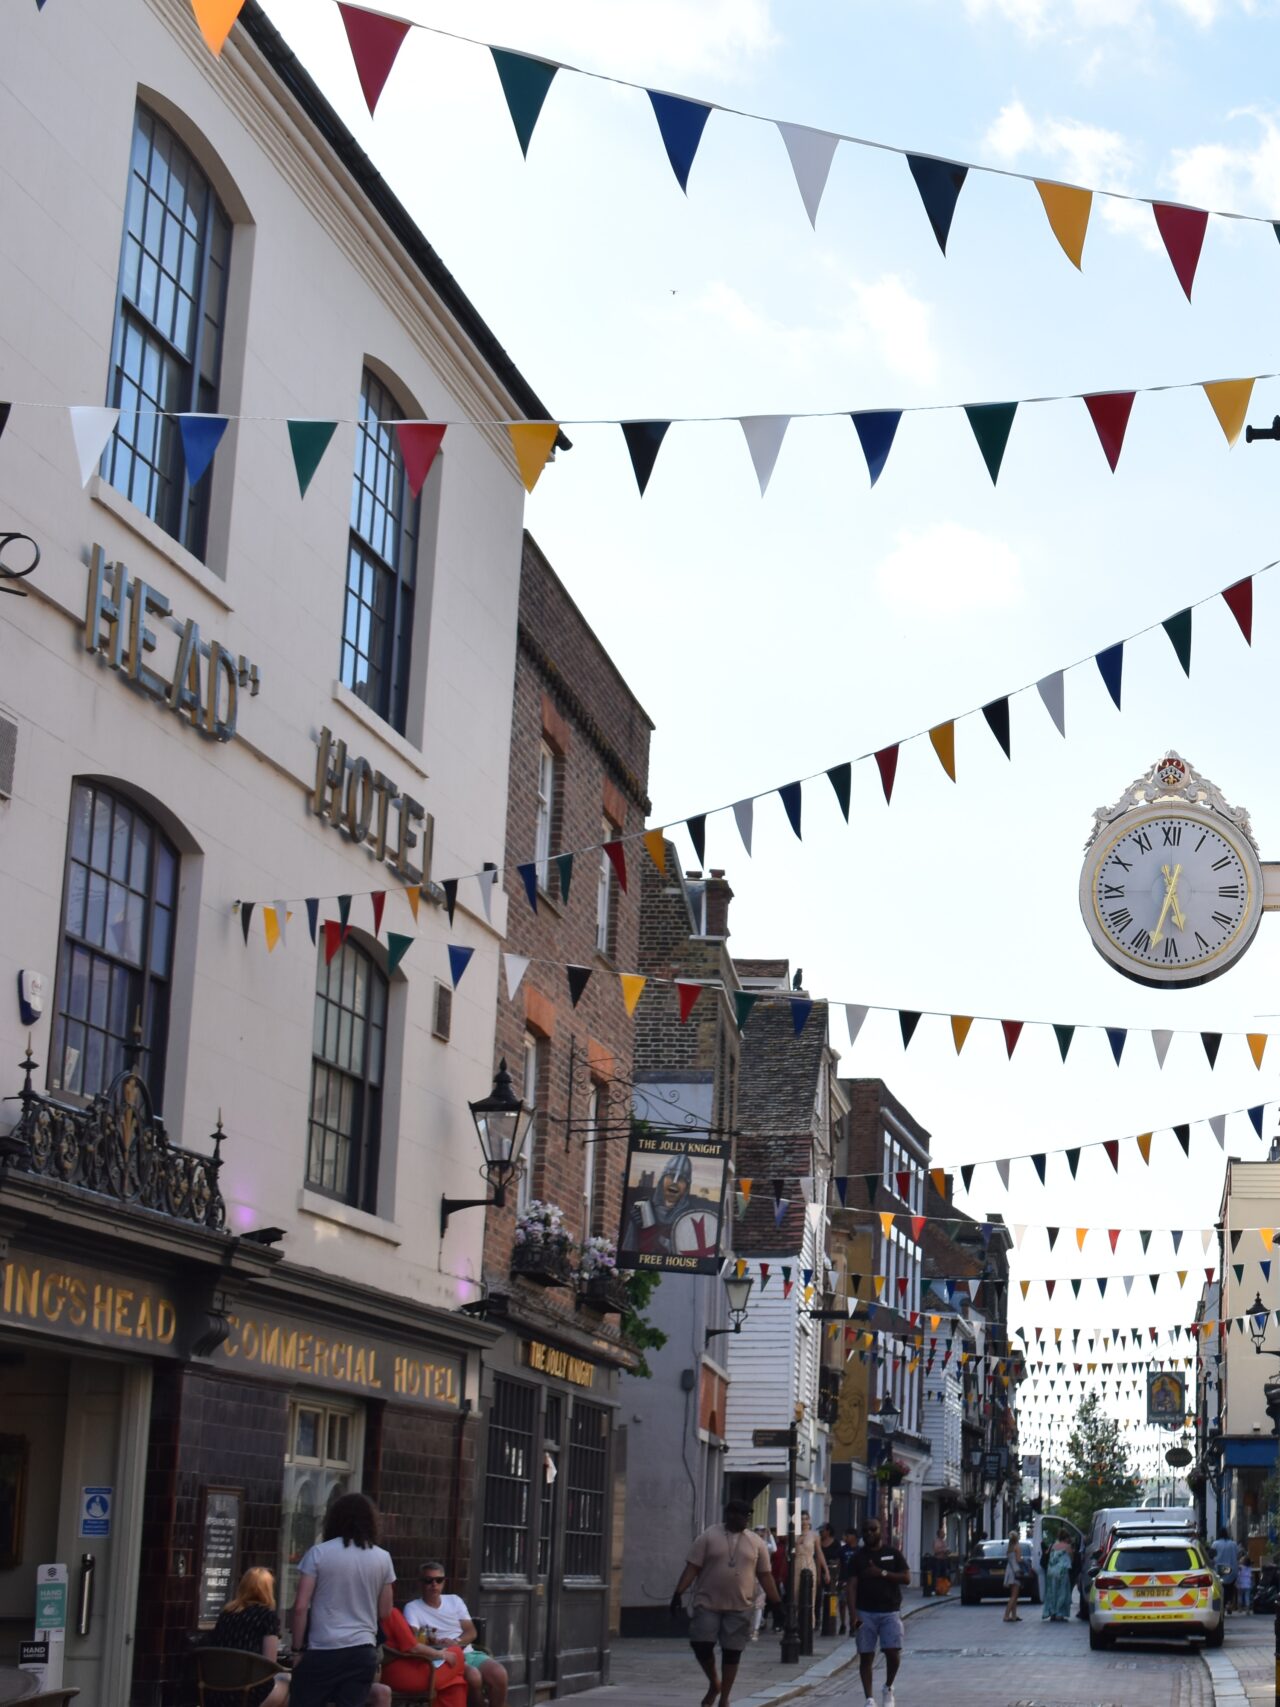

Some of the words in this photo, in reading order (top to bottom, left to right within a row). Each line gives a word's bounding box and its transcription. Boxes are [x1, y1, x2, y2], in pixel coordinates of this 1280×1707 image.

[314, 726, 446, 905] HOTEL
[1132, 832, 1152, 855] XI
[1162, 826, 1182, 847] XII
[1111, 855, 1133, 873] X
[1211, 856, 1232, 871] II
[1218, 885, 1239, 899] III
[1108, 907, 1133, 933] VIII
[1194, 931, 1209, 951] V
[639, 1139, 657, 1150] THE
[659, 1141, 687, 1152] JOLLY
[688, 1143, 722, 1155] KNIGHT
[639, 1254, 663, 1265] FREE
[665, 1256, 698, 1267] HOUSE
[3, 1263, 87, 1326] ING'S
[92, 1284, 177, 1345] HEAD
[223, 1314, 382, 1389] COMMERCIAL
[394, 1355, 457, 1404] HOTEL
[530, 1340, 546, 1370] THE
[546, 1347, 567, 1378] JOLLY
[567, 1356, 594, 1388] KNIGHT
[23, 1646, 46, 1654] HAND
